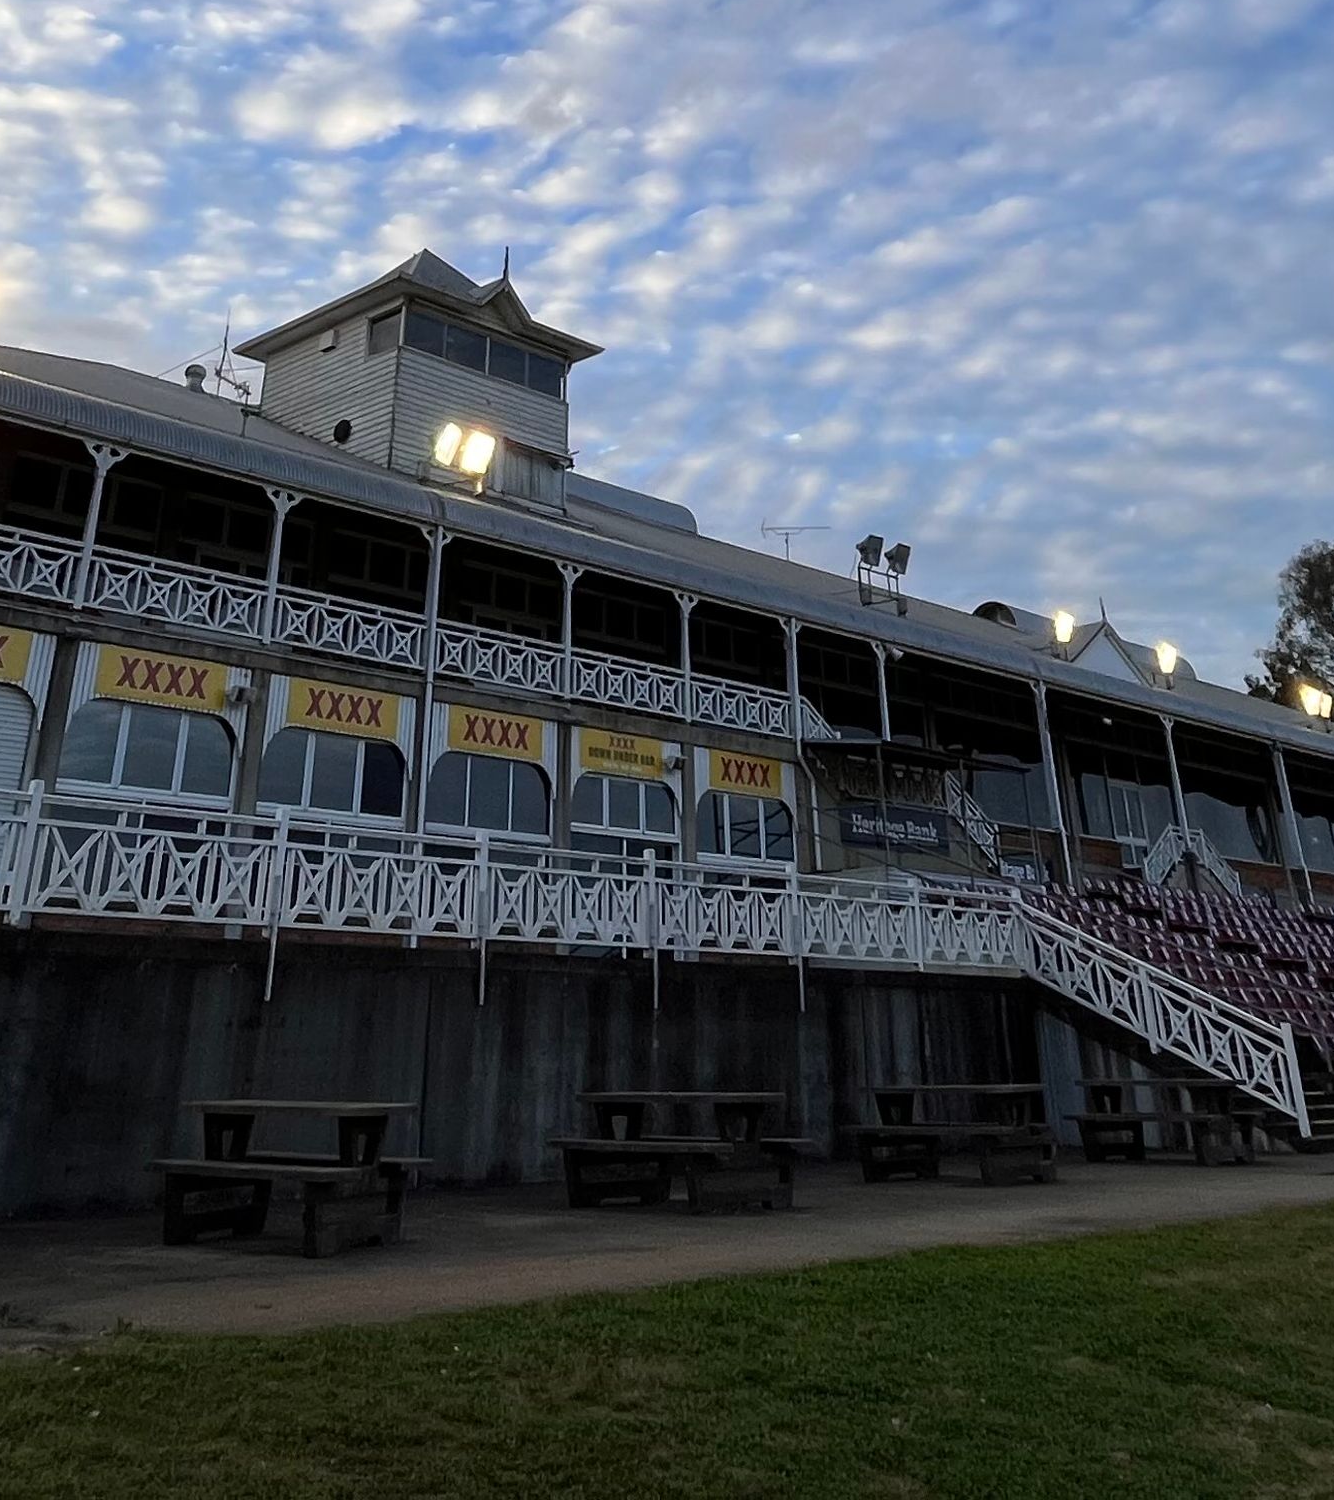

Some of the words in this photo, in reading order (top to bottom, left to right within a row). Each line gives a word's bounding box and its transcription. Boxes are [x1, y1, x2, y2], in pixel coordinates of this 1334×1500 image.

[115, 655, 209, 700] XXXX
[304, 687, 384, 728] XXXX
[463, 713, 530, 752] XXXX
[608, 735, 636, 751] XXXX
[720, 757, 772, 789] XXXX
[851, 812, 905, 843] Heritage
[905, 819, 939, 842] Bank
